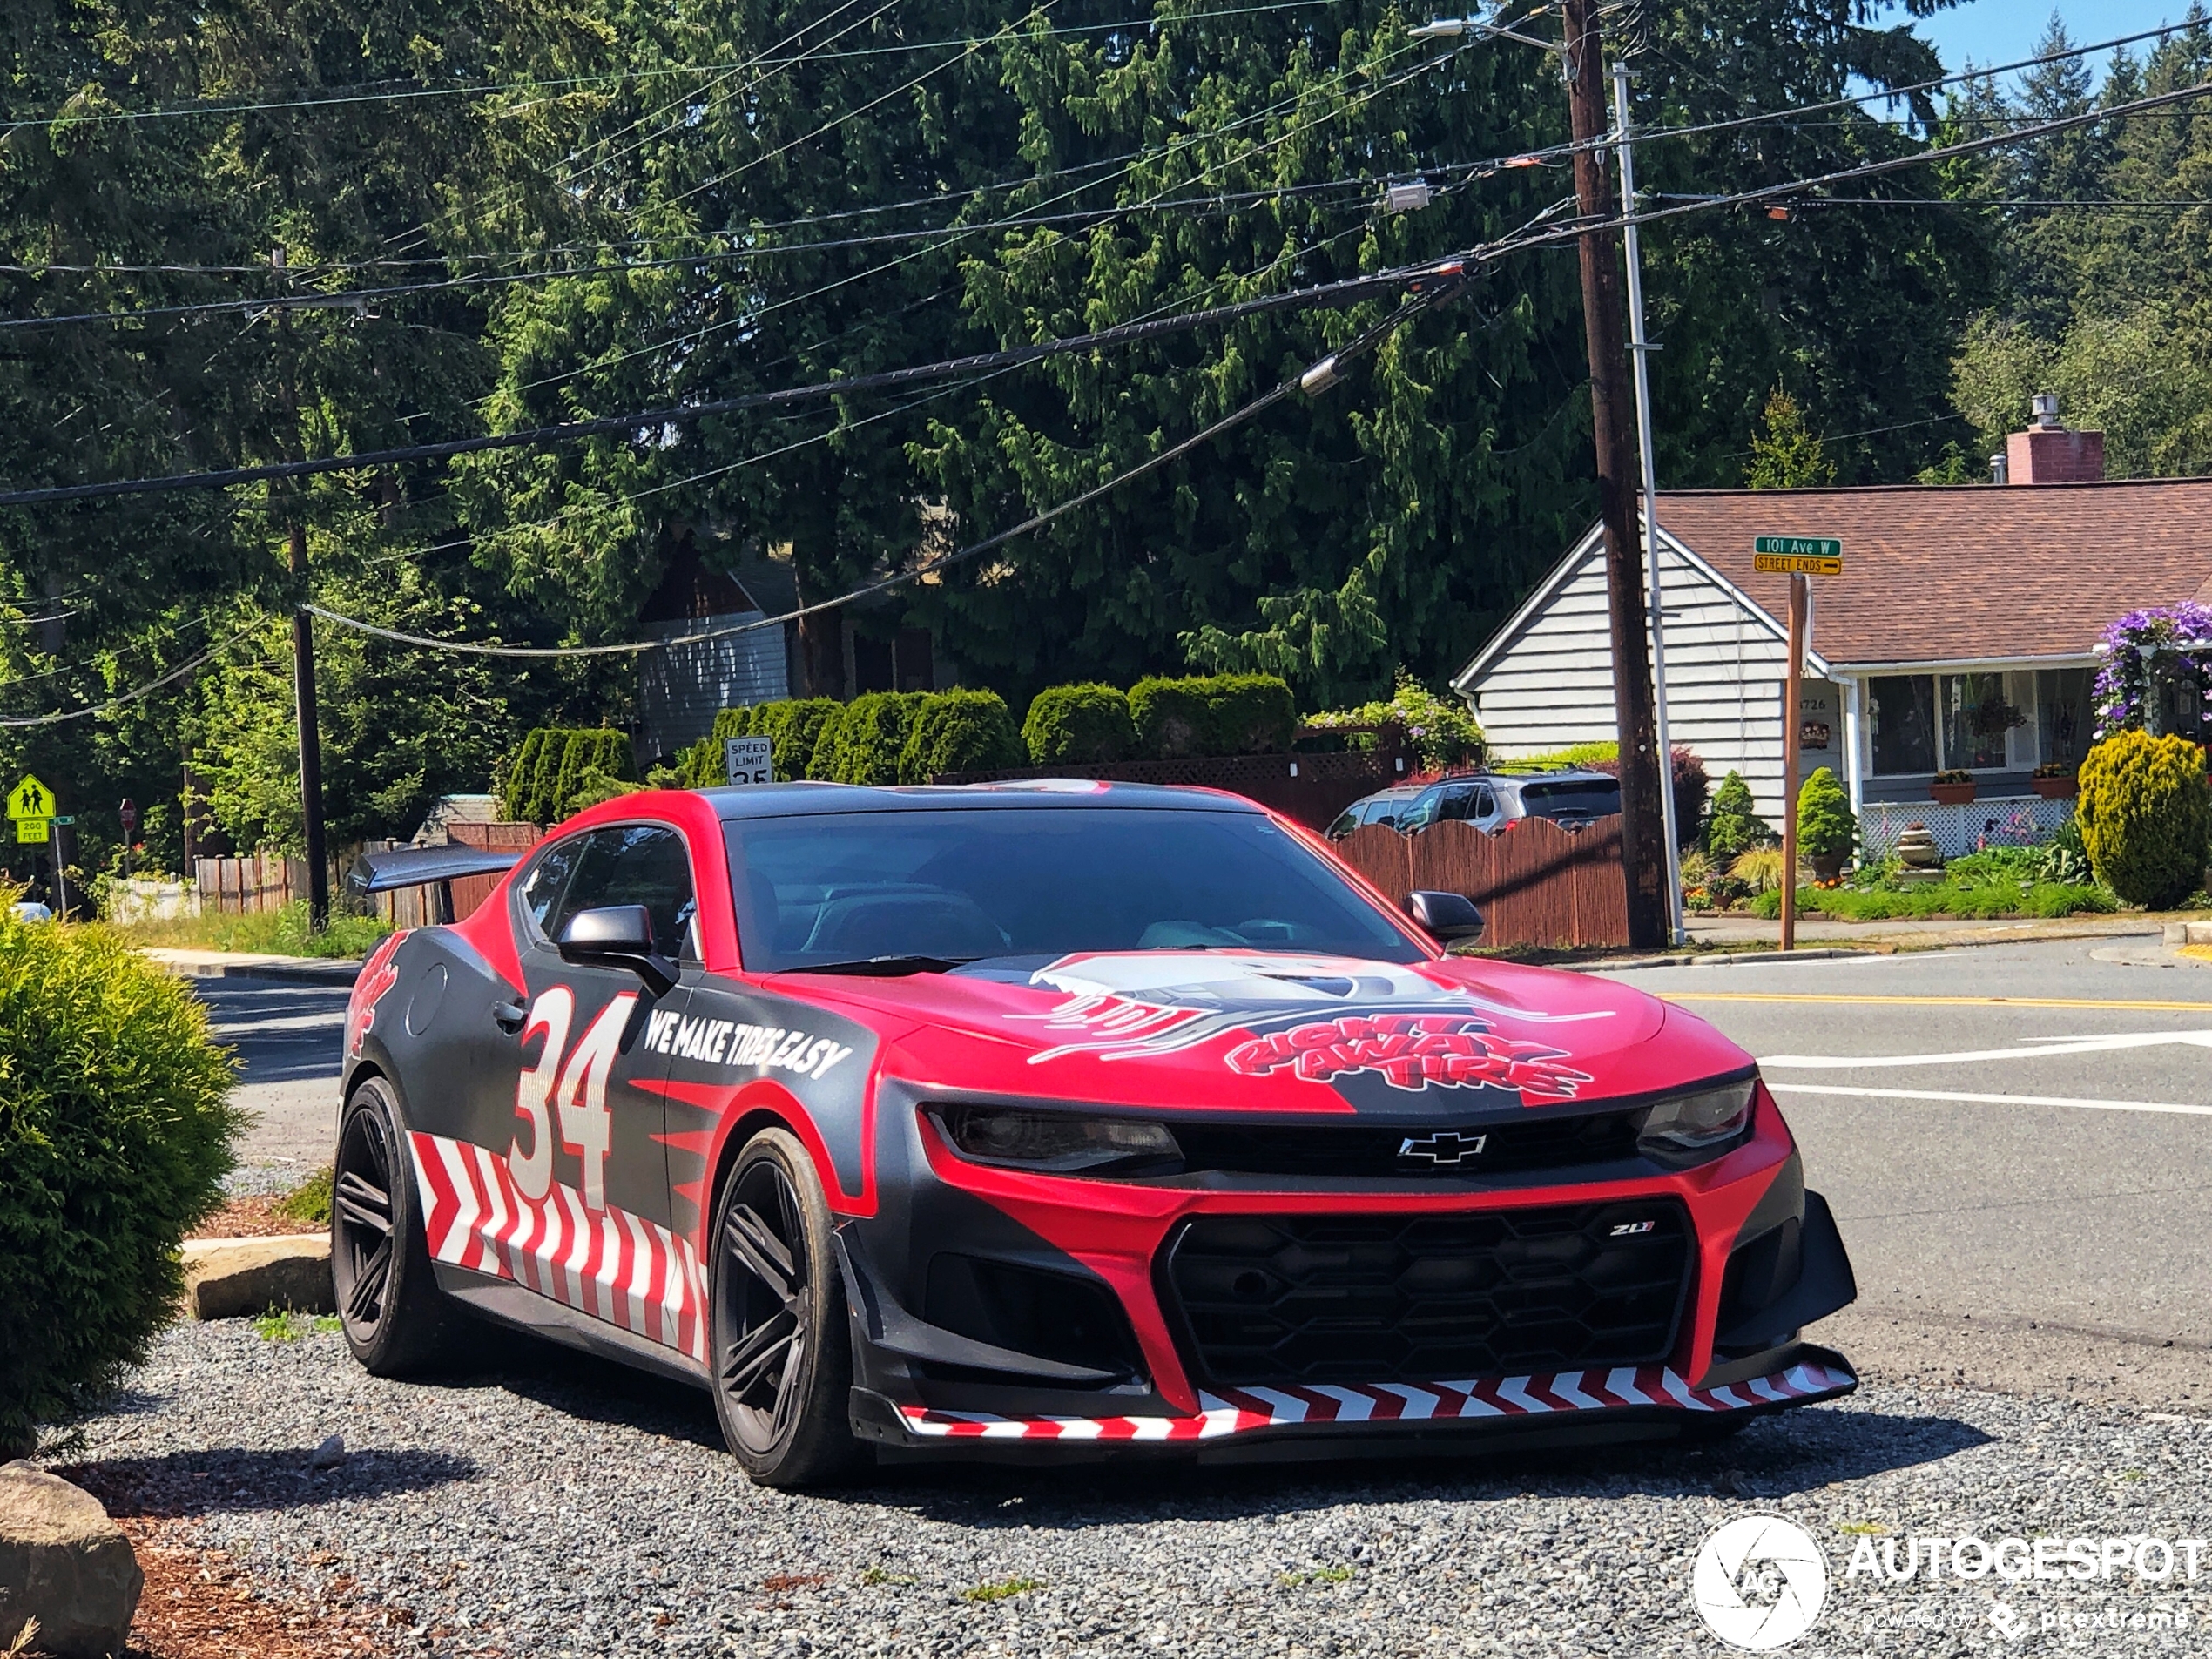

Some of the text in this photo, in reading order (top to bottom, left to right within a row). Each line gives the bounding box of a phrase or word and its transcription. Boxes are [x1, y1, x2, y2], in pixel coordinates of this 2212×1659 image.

[1766, 539, 1831, 554] 101 Ave W
[1757, 556, 1821, 571] STREET ENDS
[731, 743, 768, 754] SPEED
[735, 755, 764, 766] LIMIT
[23, 832, 43, 840] FEET
[644, 1008, 853, 1081] WE MAKE TIRES EASY
[1378, 1052, 1595, 1099] TIRE
[507, 983, 639, 1212] 34
